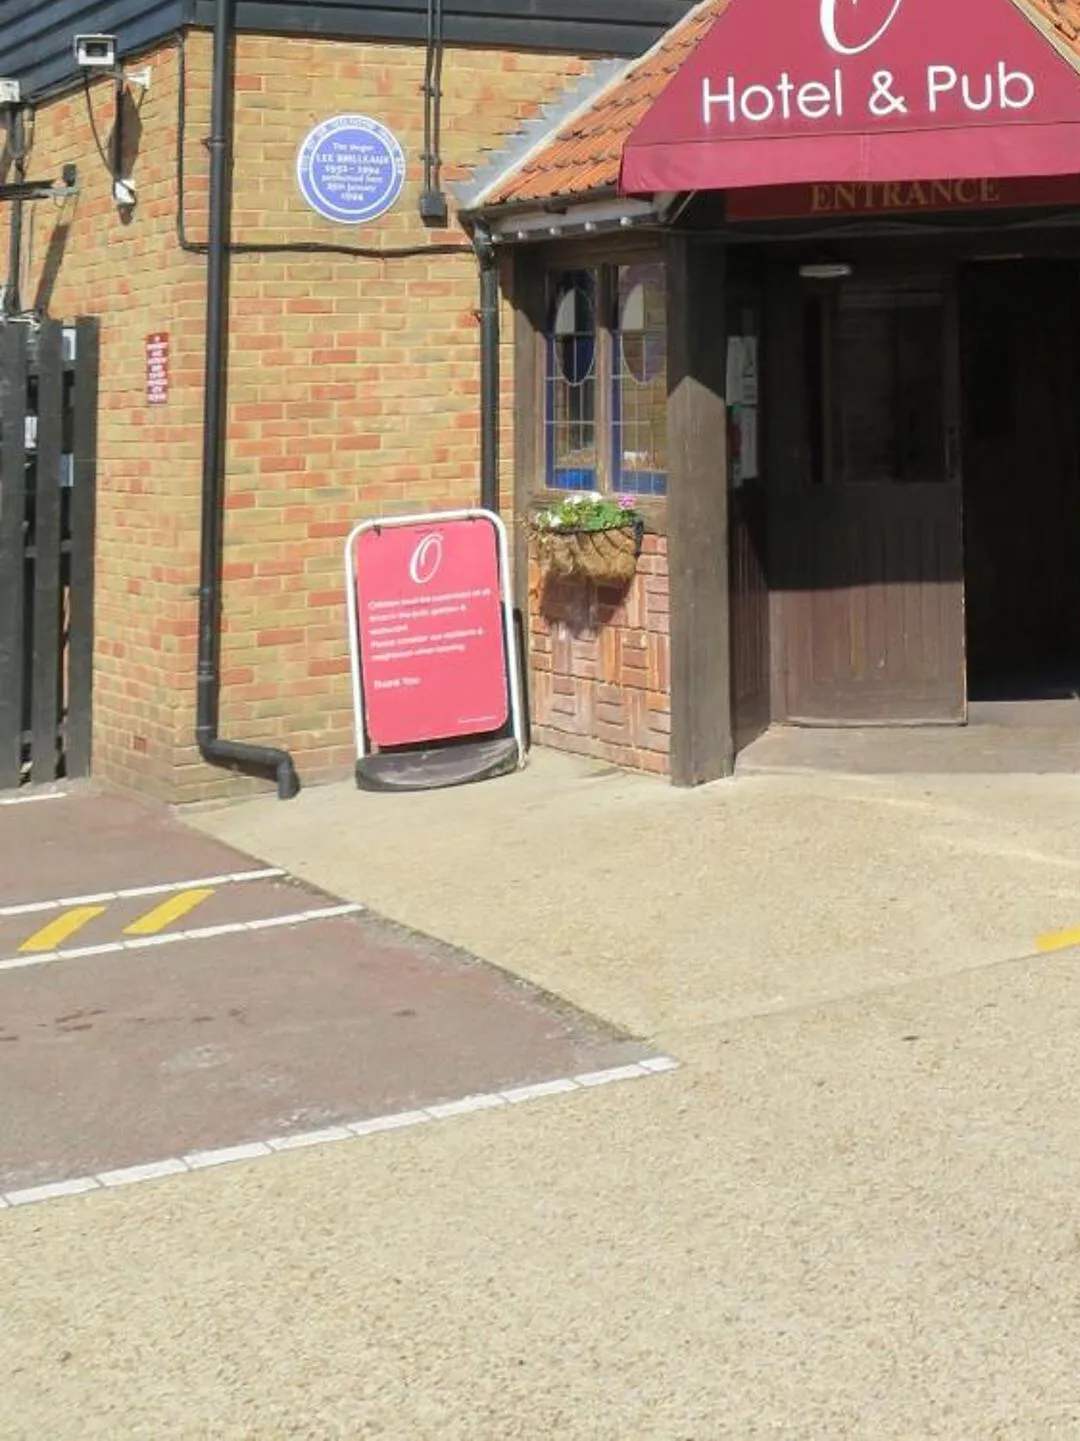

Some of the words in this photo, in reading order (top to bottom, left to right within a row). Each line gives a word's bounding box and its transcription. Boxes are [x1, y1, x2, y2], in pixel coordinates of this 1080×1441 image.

[702, 69, 843, 124] Hotel
[868, 70, 907, 115] &
[926, 61, 1035, 112] Pub
[810, 178, 1001, 211] ENTRANCE
